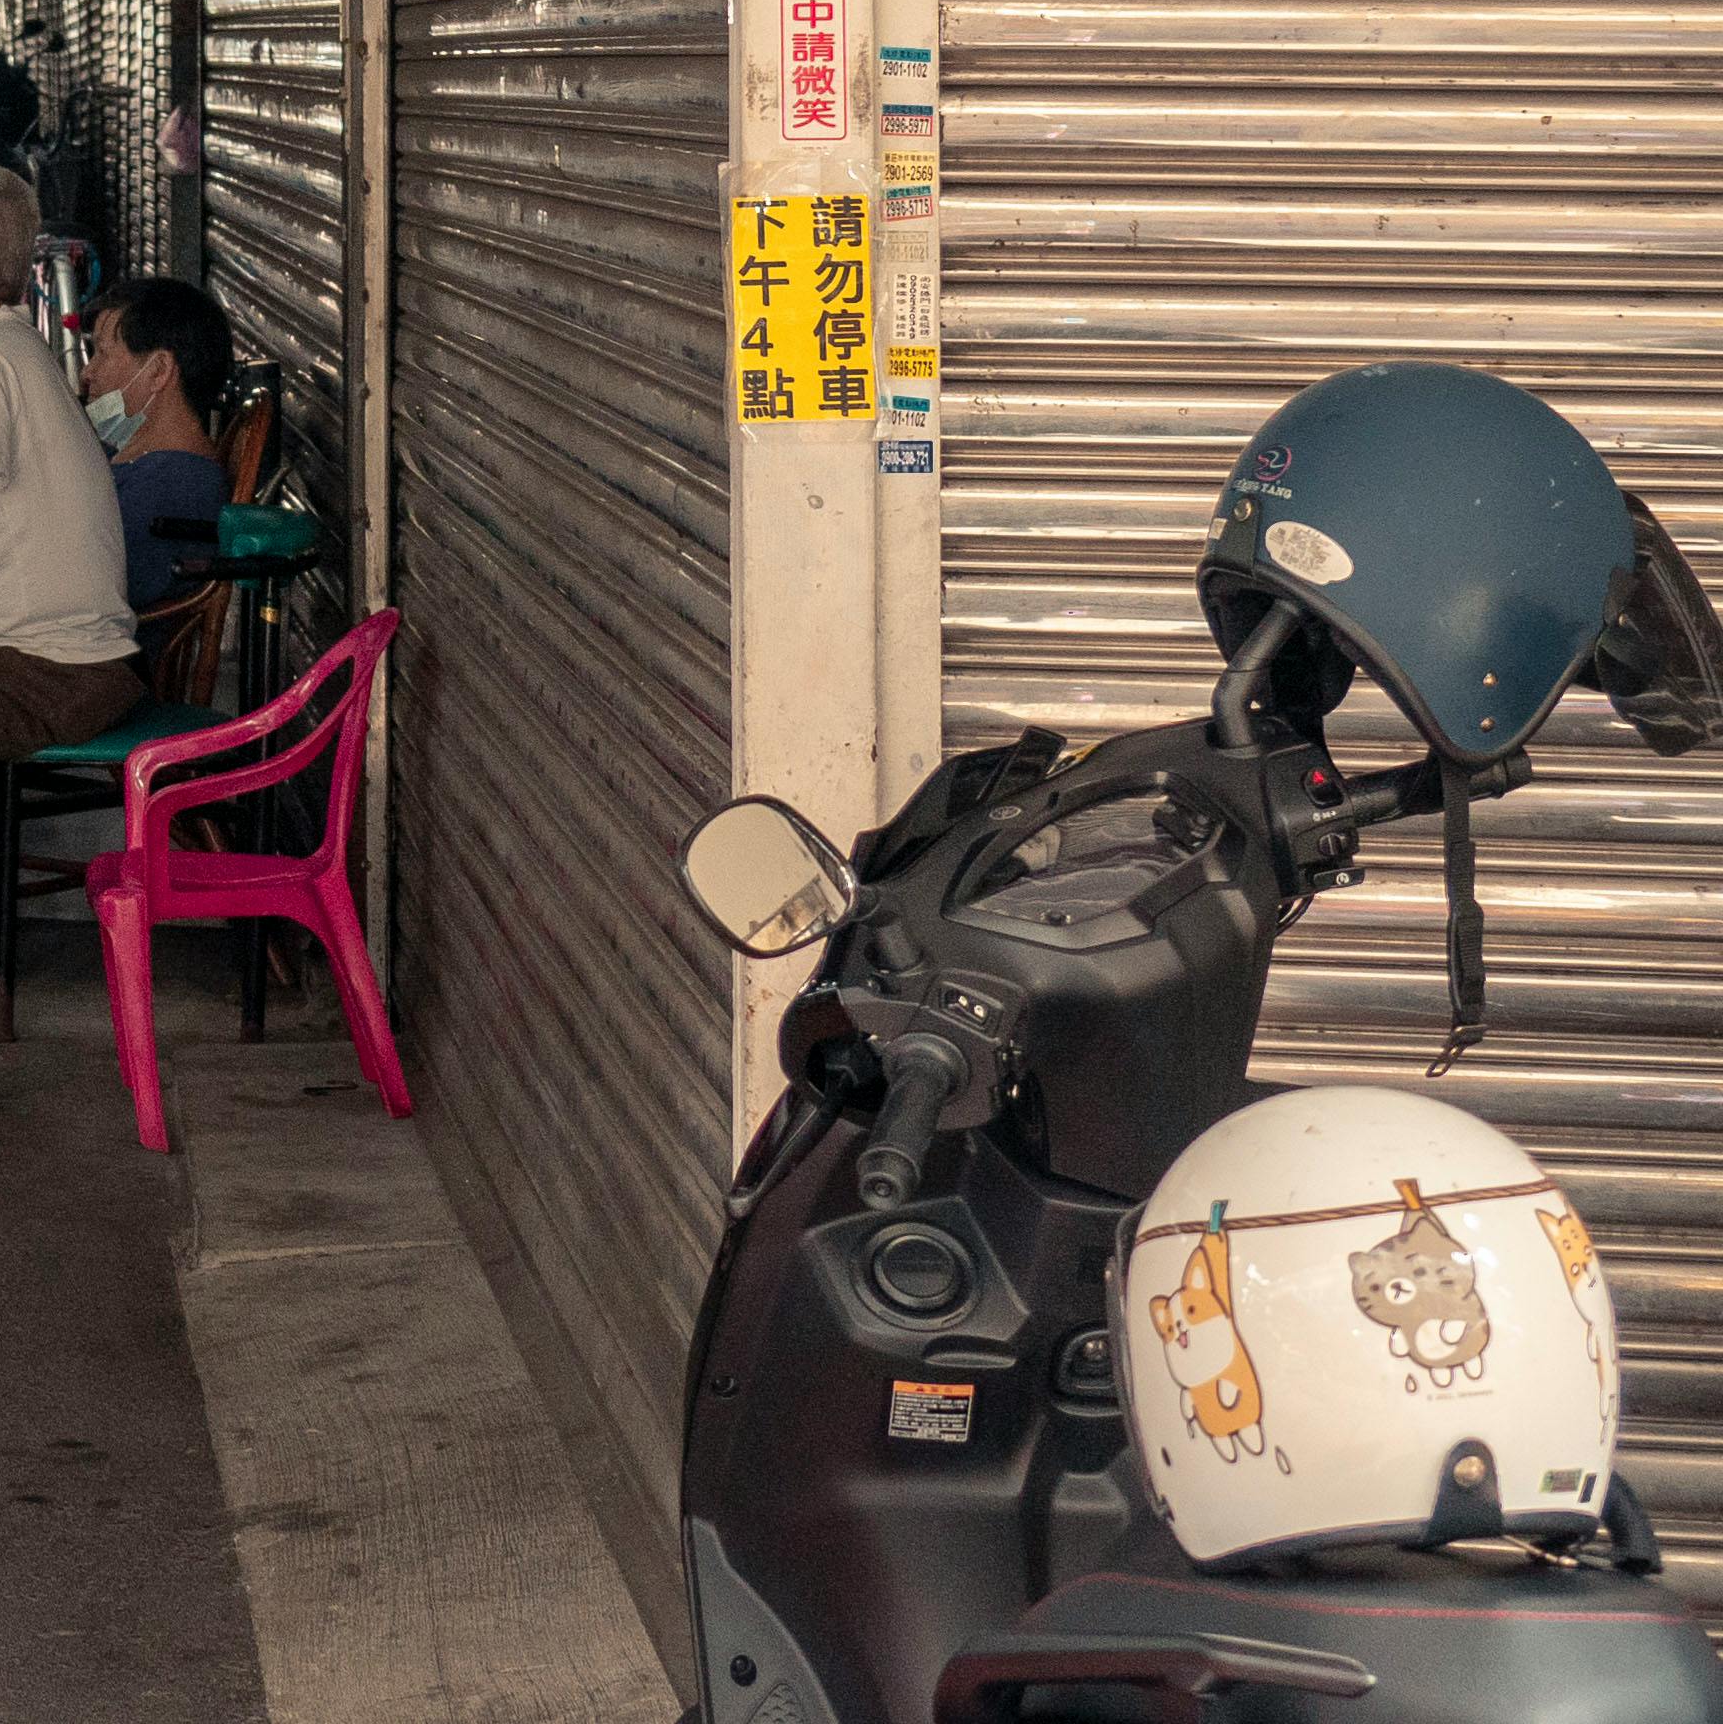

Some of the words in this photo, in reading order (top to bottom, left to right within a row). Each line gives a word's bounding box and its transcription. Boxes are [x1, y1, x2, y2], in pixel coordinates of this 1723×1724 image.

[737, 198, 796, 419] 下午4點
[810, 194, 871, 419] 請勿停車
